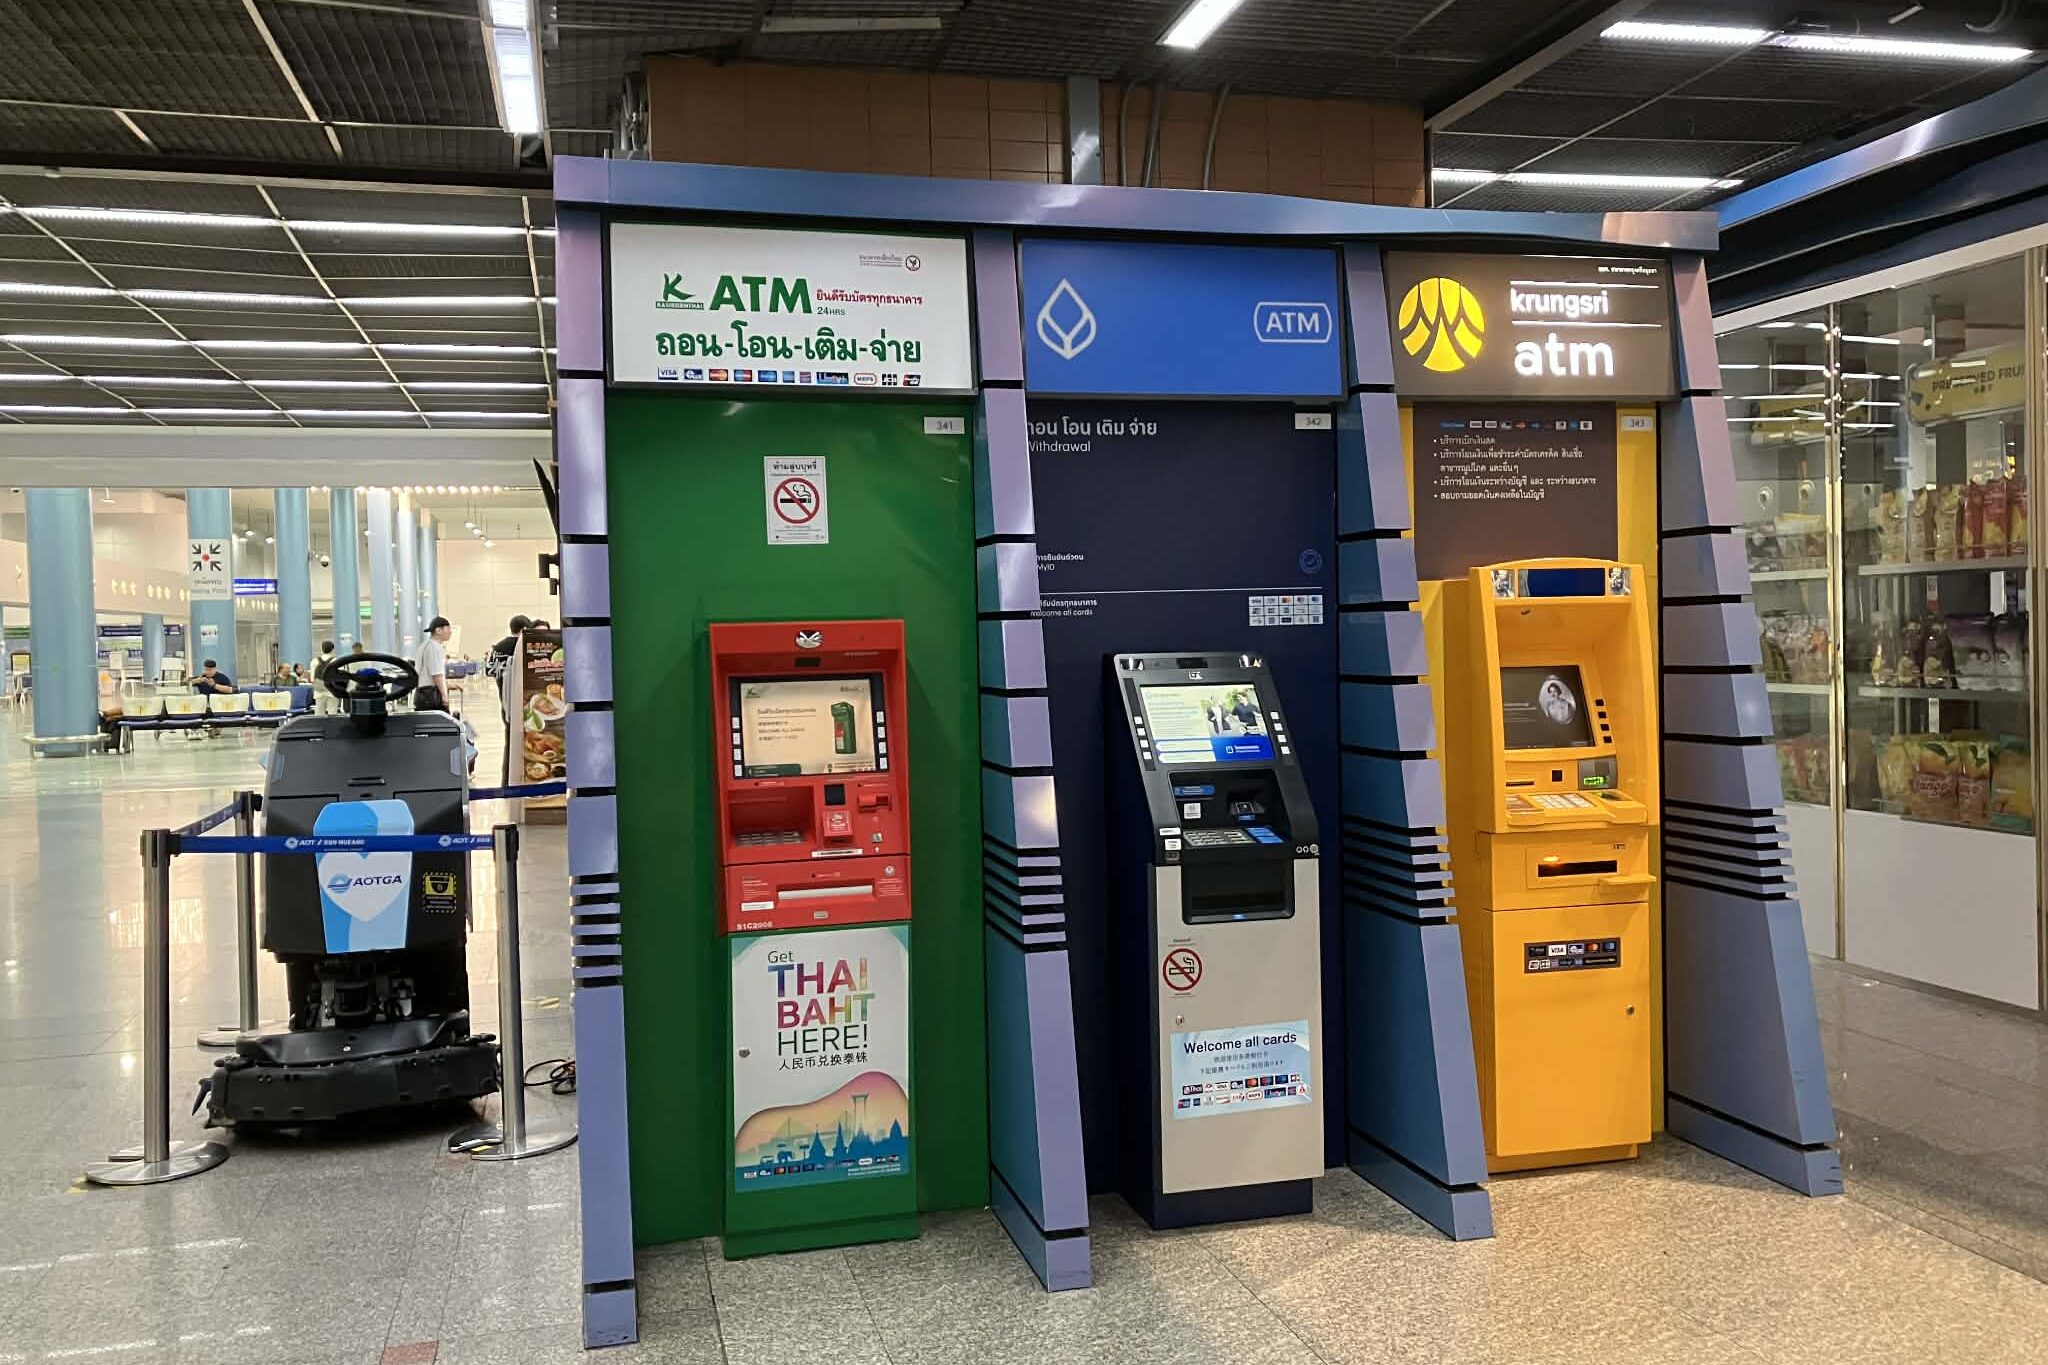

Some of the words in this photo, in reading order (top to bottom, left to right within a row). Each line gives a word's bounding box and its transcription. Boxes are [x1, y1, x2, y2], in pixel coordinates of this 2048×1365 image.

[662, 272, 696, 301] K
[709, 274, 812, 314] ATM
[816, 289, 923, 307] ยินดีรับบัตรทุกธนาคาร
[1510, 287, 1609, 317] krungsri
[1265, 311, 1320, 333] ATM
[655, 320, 921, 363] ถอน-โอน-เติม-จ่าย
[1514, 332, 1615, 377] atm
[936, 420, 953, 431] 341
[1062, 415, 1091, 436] โอน
[1096, 419, 1125, 436] เติม
[1129, 418, 1158, 436] จ่าย
[1304, 416, 1322, 427] 342
[353, 875, 402, 887] AOTGA
[767, 950, 795, 963] Get
[768, 957, 869, 997] THAI
[777, 992, 875, 1029] BAHT
[778, 1023, 868, 1057] HERE!
[1184, 1040, 1242, 1054] Welcome
[1245, 1036, 1259, 1048] all
[1263, 1032, 1297, 1045] cards
[778, 1052, 869, 1071] 人民币兑换泰铢
